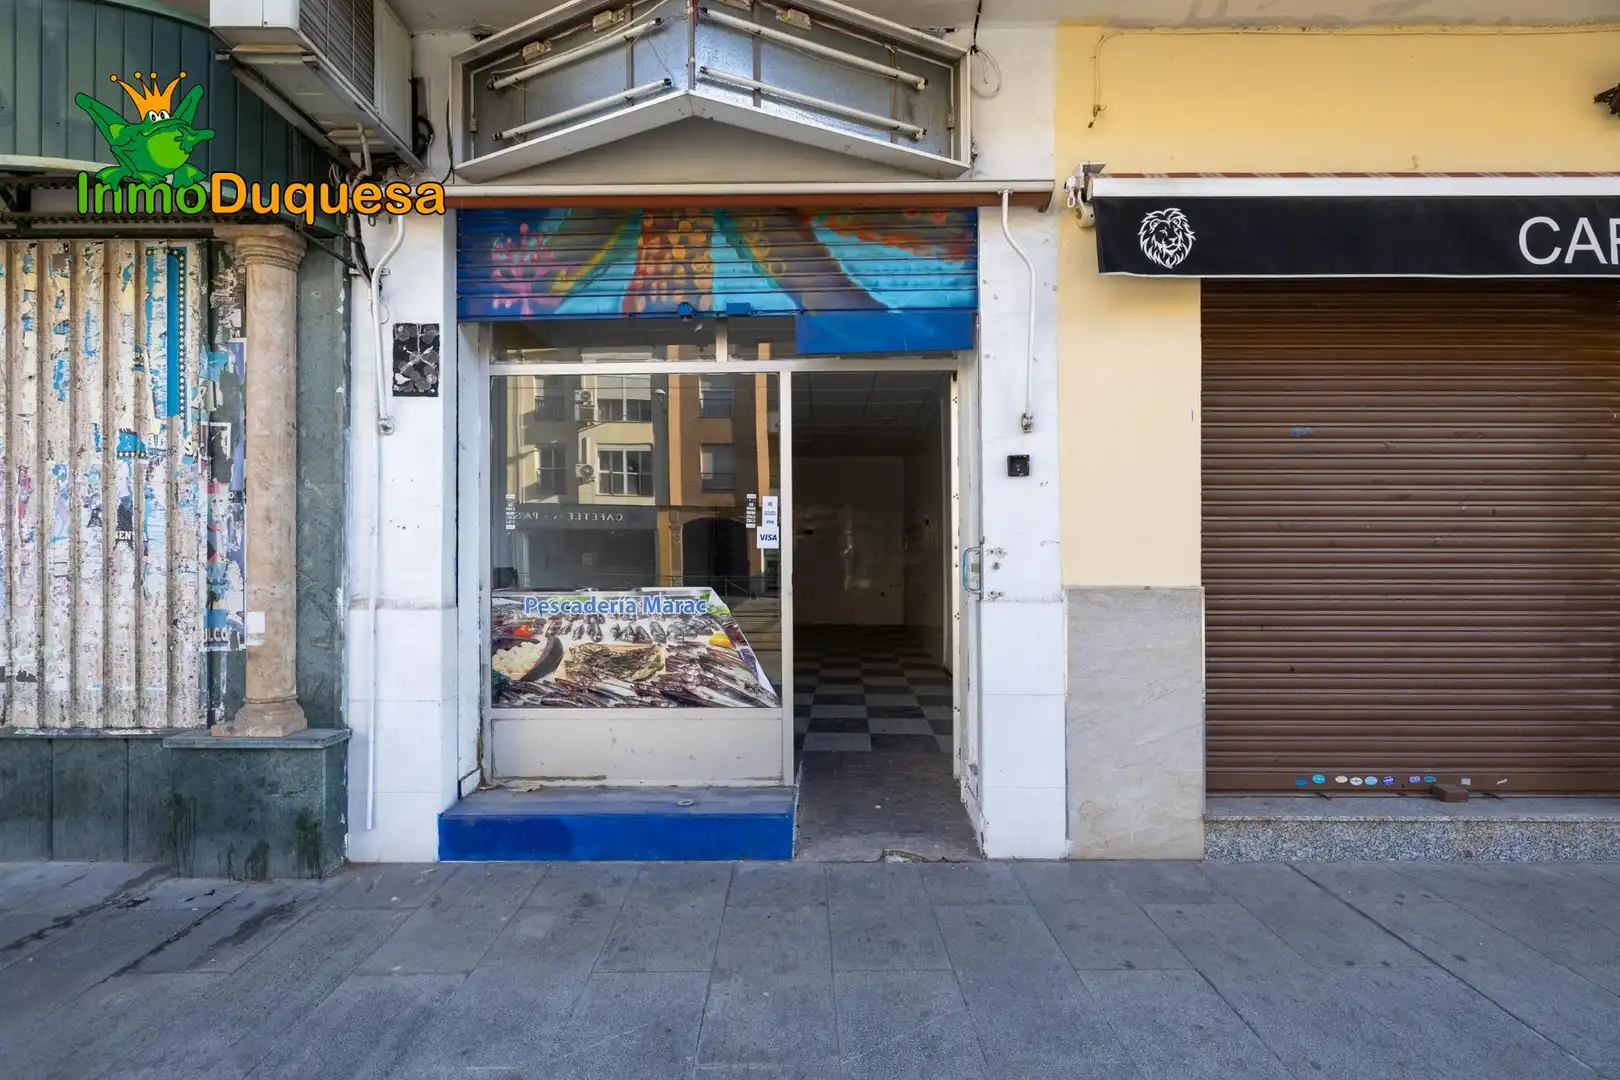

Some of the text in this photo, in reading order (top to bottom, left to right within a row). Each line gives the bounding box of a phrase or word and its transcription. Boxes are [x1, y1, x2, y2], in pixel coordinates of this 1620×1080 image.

[760, 533, 778, 541] VISA
[524, 595, 708, 615] Pescadería Marac
